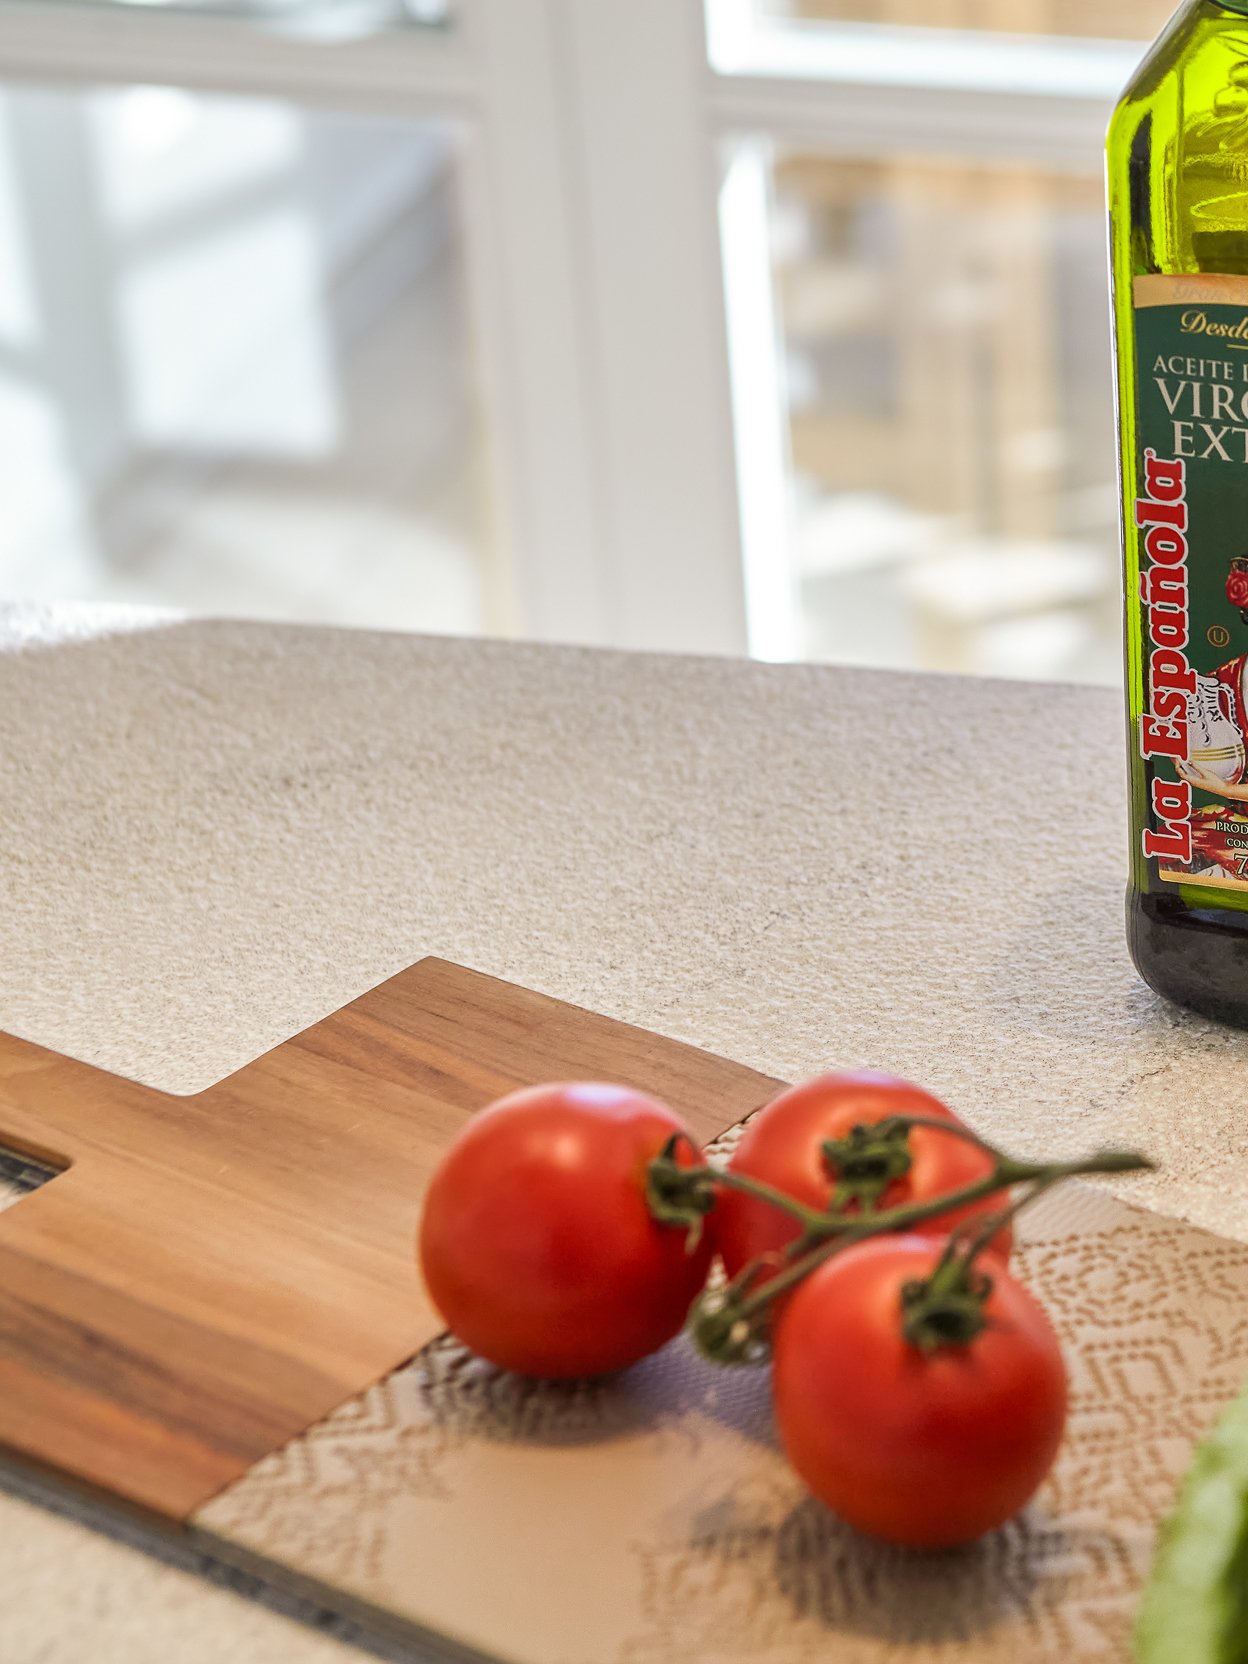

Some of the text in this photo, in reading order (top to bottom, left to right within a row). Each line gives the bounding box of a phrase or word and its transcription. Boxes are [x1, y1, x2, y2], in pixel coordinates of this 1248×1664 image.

[1153, 355, 1234, 381] ACEITE
[1134, 455, 1198, 865] La Española
